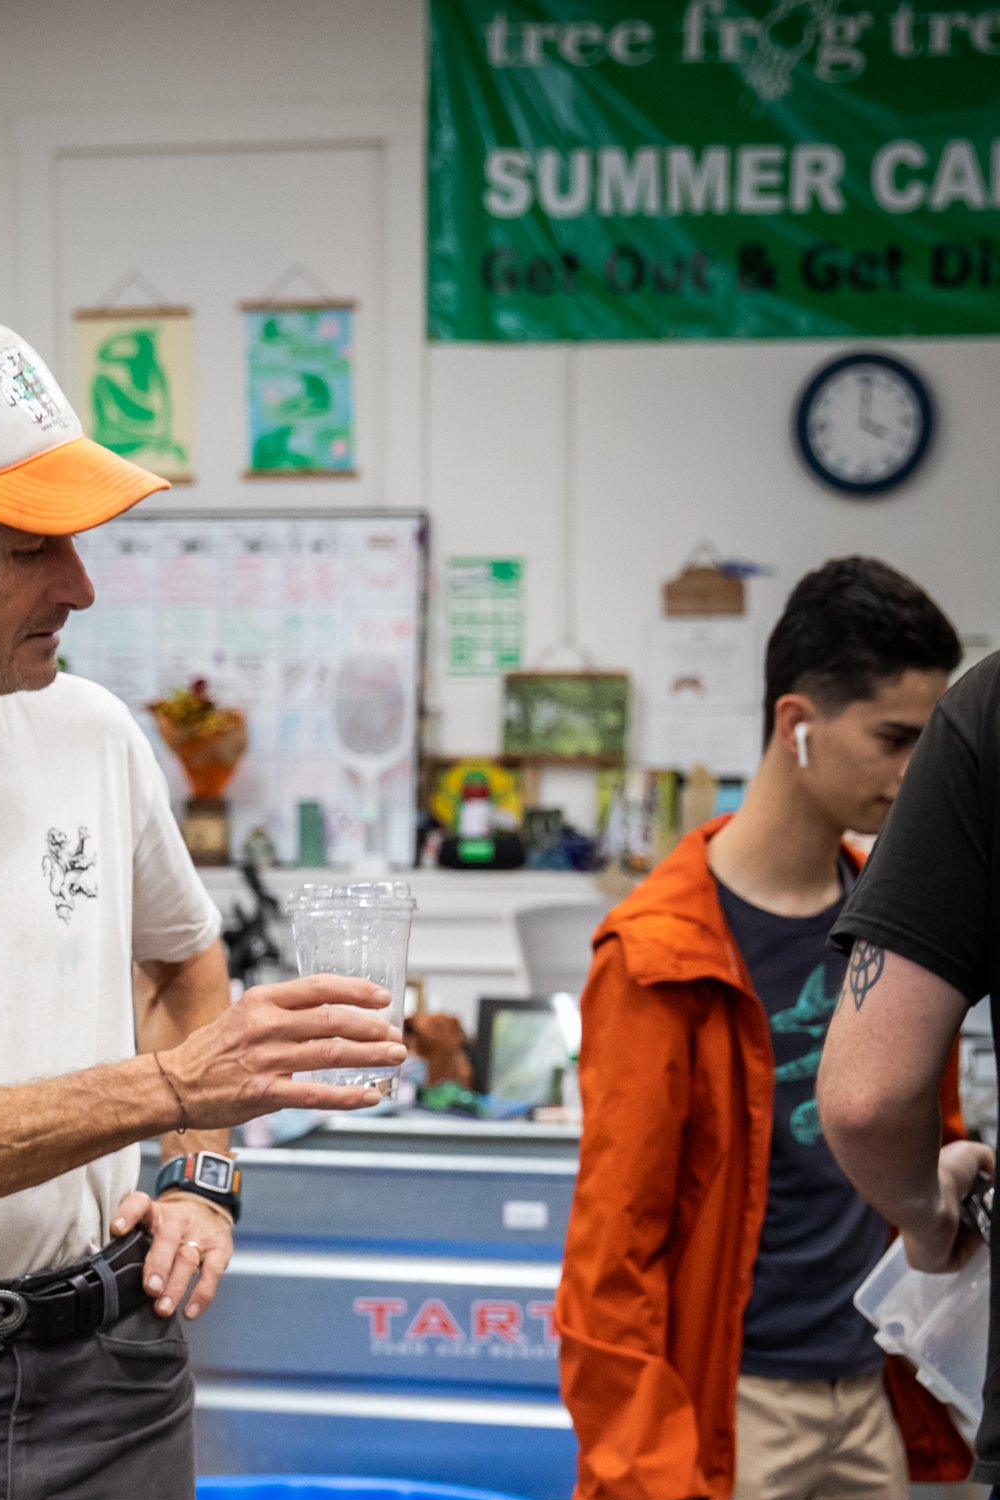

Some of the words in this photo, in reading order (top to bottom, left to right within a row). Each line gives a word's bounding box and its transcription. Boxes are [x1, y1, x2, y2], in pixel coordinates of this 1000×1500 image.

[482, 10, 656, 69] tree
[483, 144, 847, 219] SUMMER
[869, 138, 1000, 215] CA
[482, 245, 578, 295] Get
[604, 245, 711, 294] Out
[736, 243, 777, 291] &
[801, 243, 903, 291] Get
